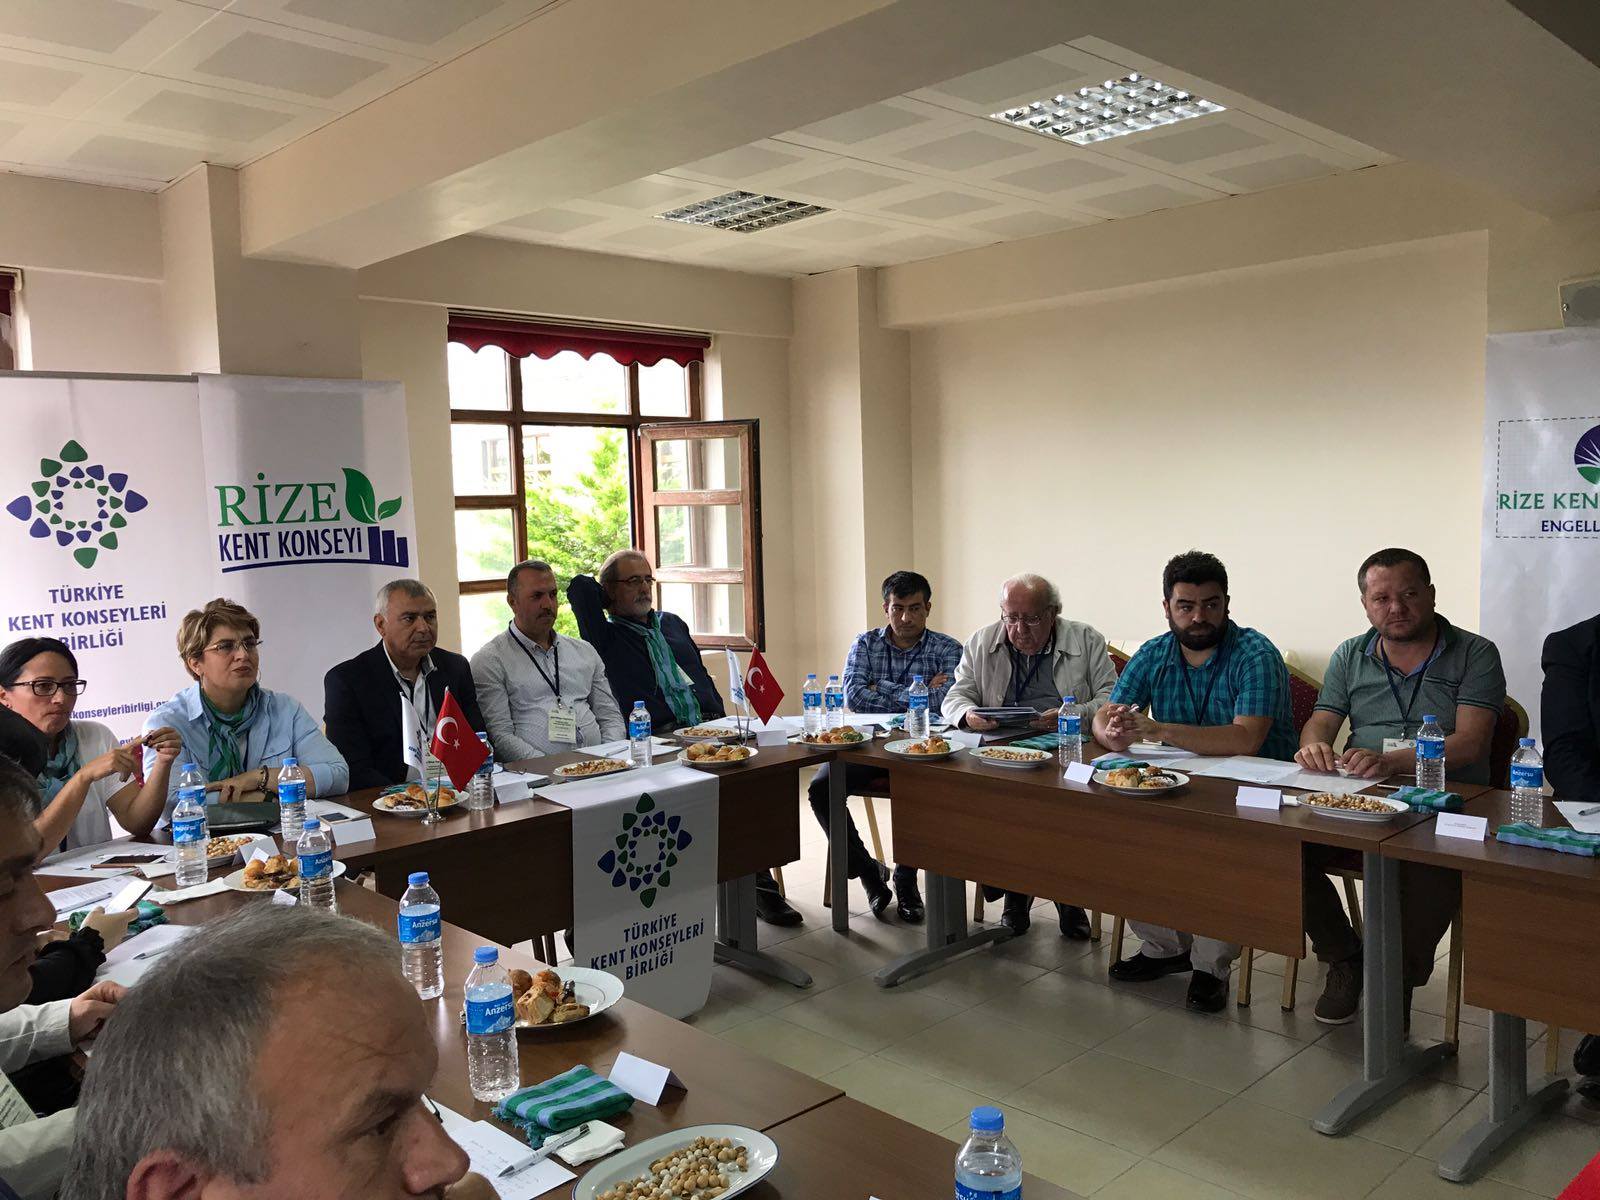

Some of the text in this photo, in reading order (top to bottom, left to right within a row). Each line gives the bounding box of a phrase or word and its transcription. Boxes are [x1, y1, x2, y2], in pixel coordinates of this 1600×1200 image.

[215, 471, 341, 527] RİZE
[1499, 490, 1545, 510] RİZE
[1541, 519, 1600, 532] ENGELL
[218, 526, 363, 562] KENT KONSEYİ
[48, 582, 124, 604] TÜRKİYE
[8, 601, 167, 632] KENT KONSEYLERİ
[61, 628, 124, 651] BİRLİĞİ
[69, 700, 168, 719] konseyleribirligi.o
[623, 912, 678, 944] TÜRKİYE
[590, 918, 705, 971] KENT KONSEYLERİ
[625, 949, 673, 981] BİRLİĞİ
